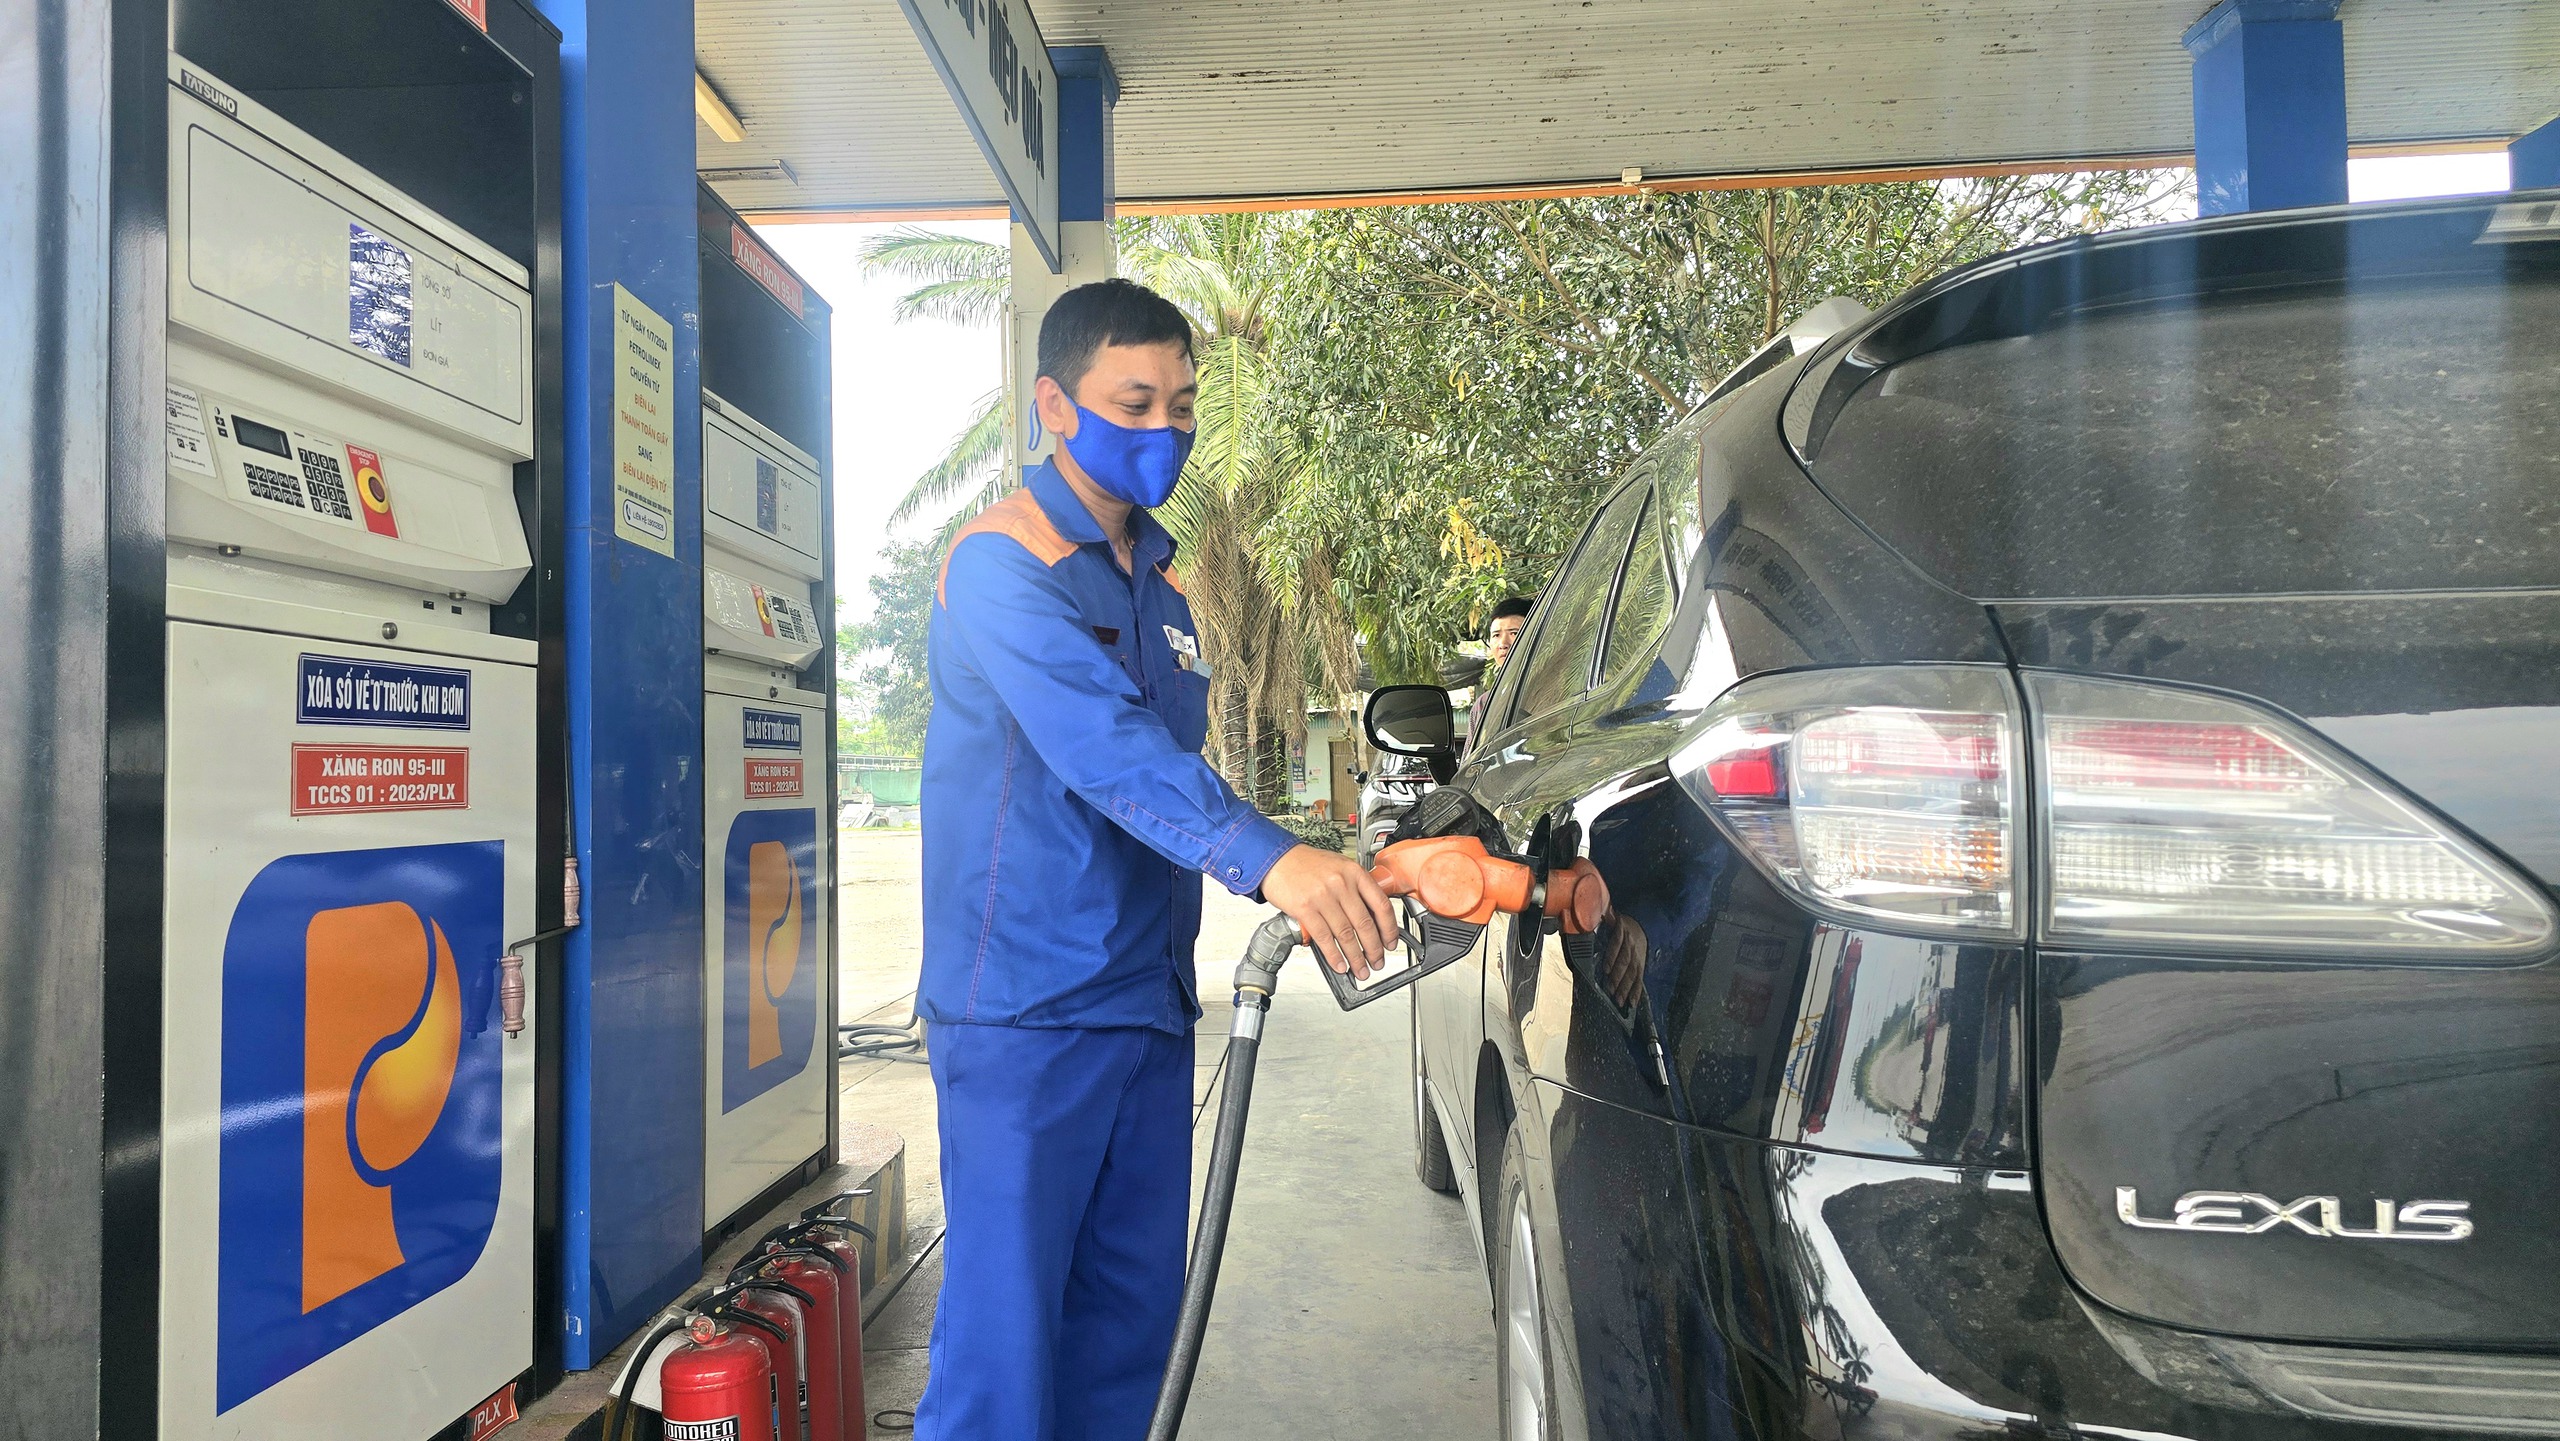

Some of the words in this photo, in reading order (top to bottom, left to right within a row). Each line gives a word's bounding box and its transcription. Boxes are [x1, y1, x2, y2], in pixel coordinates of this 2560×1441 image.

[184, 71, 236, 113] TATSUNO
[1022, 66, 1044, 180] QUẢ
[737, 239, 762, 277] XĂNG
[764, 264, 780, 292] RON
[430, 317, 442, 333] LÍT
[622, 309, 630, 323] TỪ
[630, 316, 646, 336] NGÀY
[646, 329, 668, 352] 1/7/2024
[629, 340, 661, 372] PETROLIMEX
[652, 380, 660, 393] TỪ
[648, 403, 656, 416] LAI
[621, 410, 641, 431] THANH
[641, 422, 656, 440] TOÁN
[300, 450, 305, 461] 7
[311, 453, 317, 464] 8
[321, 456, 327, 467] 9
[358, 456, 370, 466] STOP
[638, 445, 652, 462] SANG
[245, 466, 255, 476] P1
[257, 470, 266, 480] P2
[268, 472, 277, 482] P3
[279, 476, 288, 485] P4
[305, 466, 311, 478] 4
[315, 470, 321, 480] 5
[325, 472, 331, 483] 6
[636, 470, 646, 483] LAI
[250, 483, 260, 494] P6
[261, 486, 270, 496] P7
[310, 483, 315, 494] 1
[320, 486, 326, 498] 2
[329, 489, 335, 500] 3
[314, 499, 320, 510] 0
[324, 502, 330, 513] C
[306, 668, 332, 708] XÓA
[336, 667, 353, 710] SỐ
[356, 670, 370, 710] VỀ
[384, 677, 419, 714] TRƯỚC
[422, 685, 439, 714] KHI
[442, 684, 464, 716] BƠM
[746, 716, 755, 739] XÓA
[756, 714, 761, 739] SỐ
[322, 754, 367, 776] XĂNG
[372, 758, 404, 776] RON
[408, 758, 445, 776] 95-III
[753, 764, 769, 776] XĂNG
[770, 766, 781, 777] RON
[782, 766, 795, 776] 95-III
[308, 785, 350, 805] TCCS
[356, 785, 373, 803] 01
[389, 783, 455, 802] 2023/PLX
[750, 782, 764, 793] TCCS
[765, 782, 772, 792] 01
[776, 781, 799, 792] 2023/PLX
[2116, 1186, 2474, 1240] LEXUS
